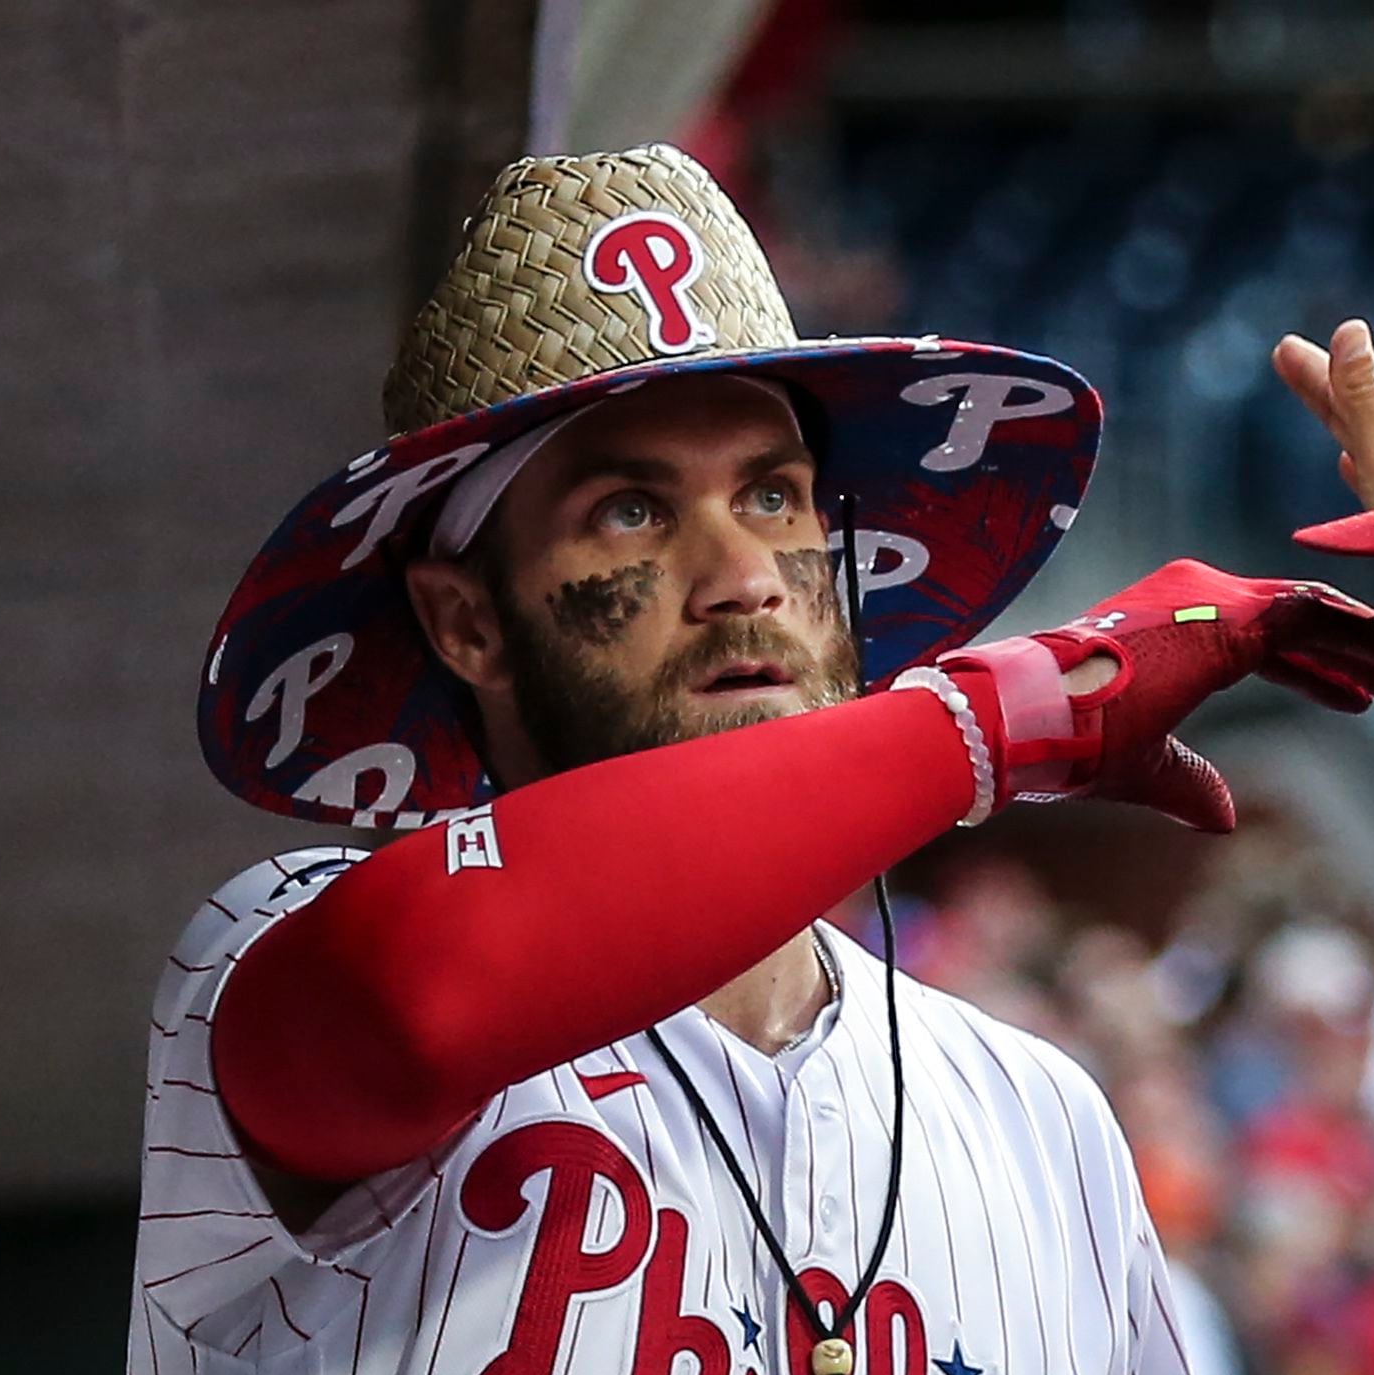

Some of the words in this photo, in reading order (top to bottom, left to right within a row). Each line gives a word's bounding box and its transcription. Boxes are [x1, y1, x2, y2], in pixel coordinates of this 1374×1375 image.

[585, 212, 704, 356] P
[899, 372, 1076, 472] P
[331, 442, 491, 571] P
[245, 632, 355, 770] P
